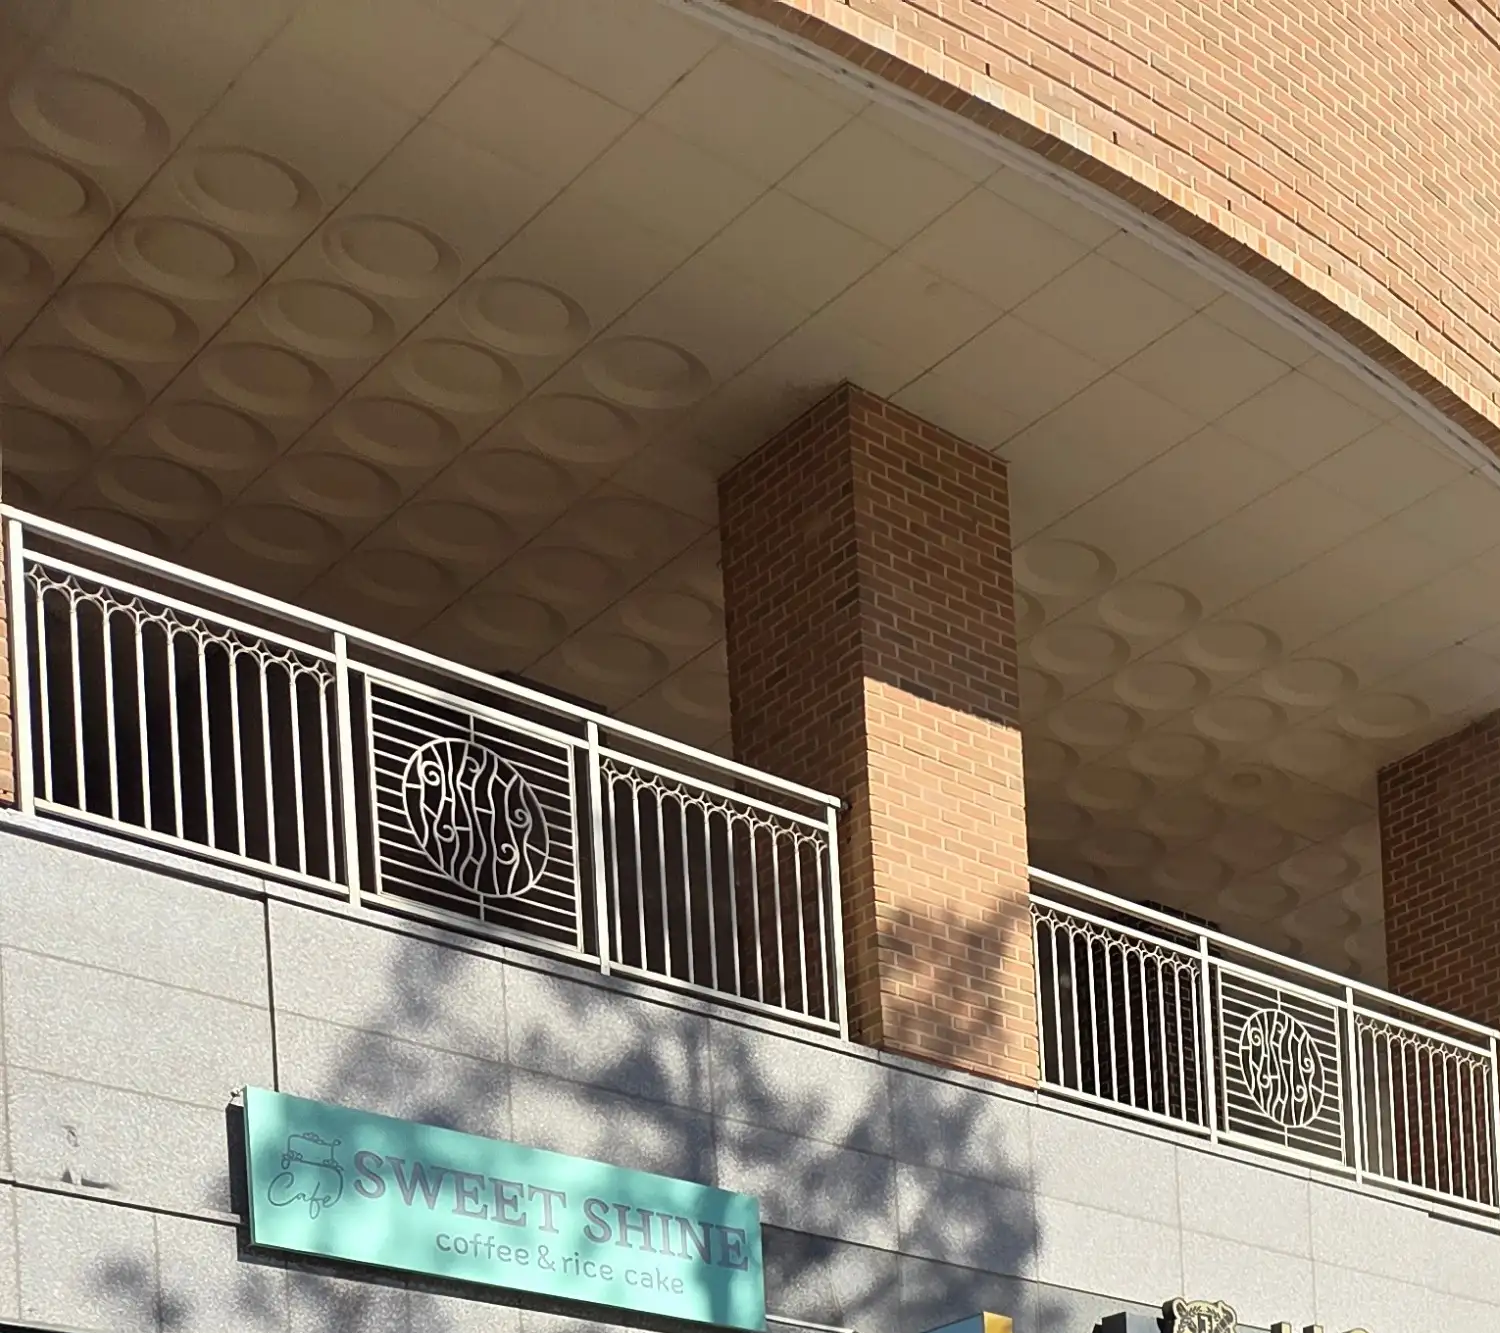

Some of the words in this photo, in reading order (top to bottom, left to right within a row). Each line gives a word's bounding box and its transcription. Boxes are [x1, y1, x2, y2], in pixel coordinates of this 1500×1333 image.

[268, 1171, 335, 1220] Cafe
[353, 1150, 567, 1234] SWEET
[582, 1197, 749, 1273] SHINE
[624, 1266, 684, 1295] cake
